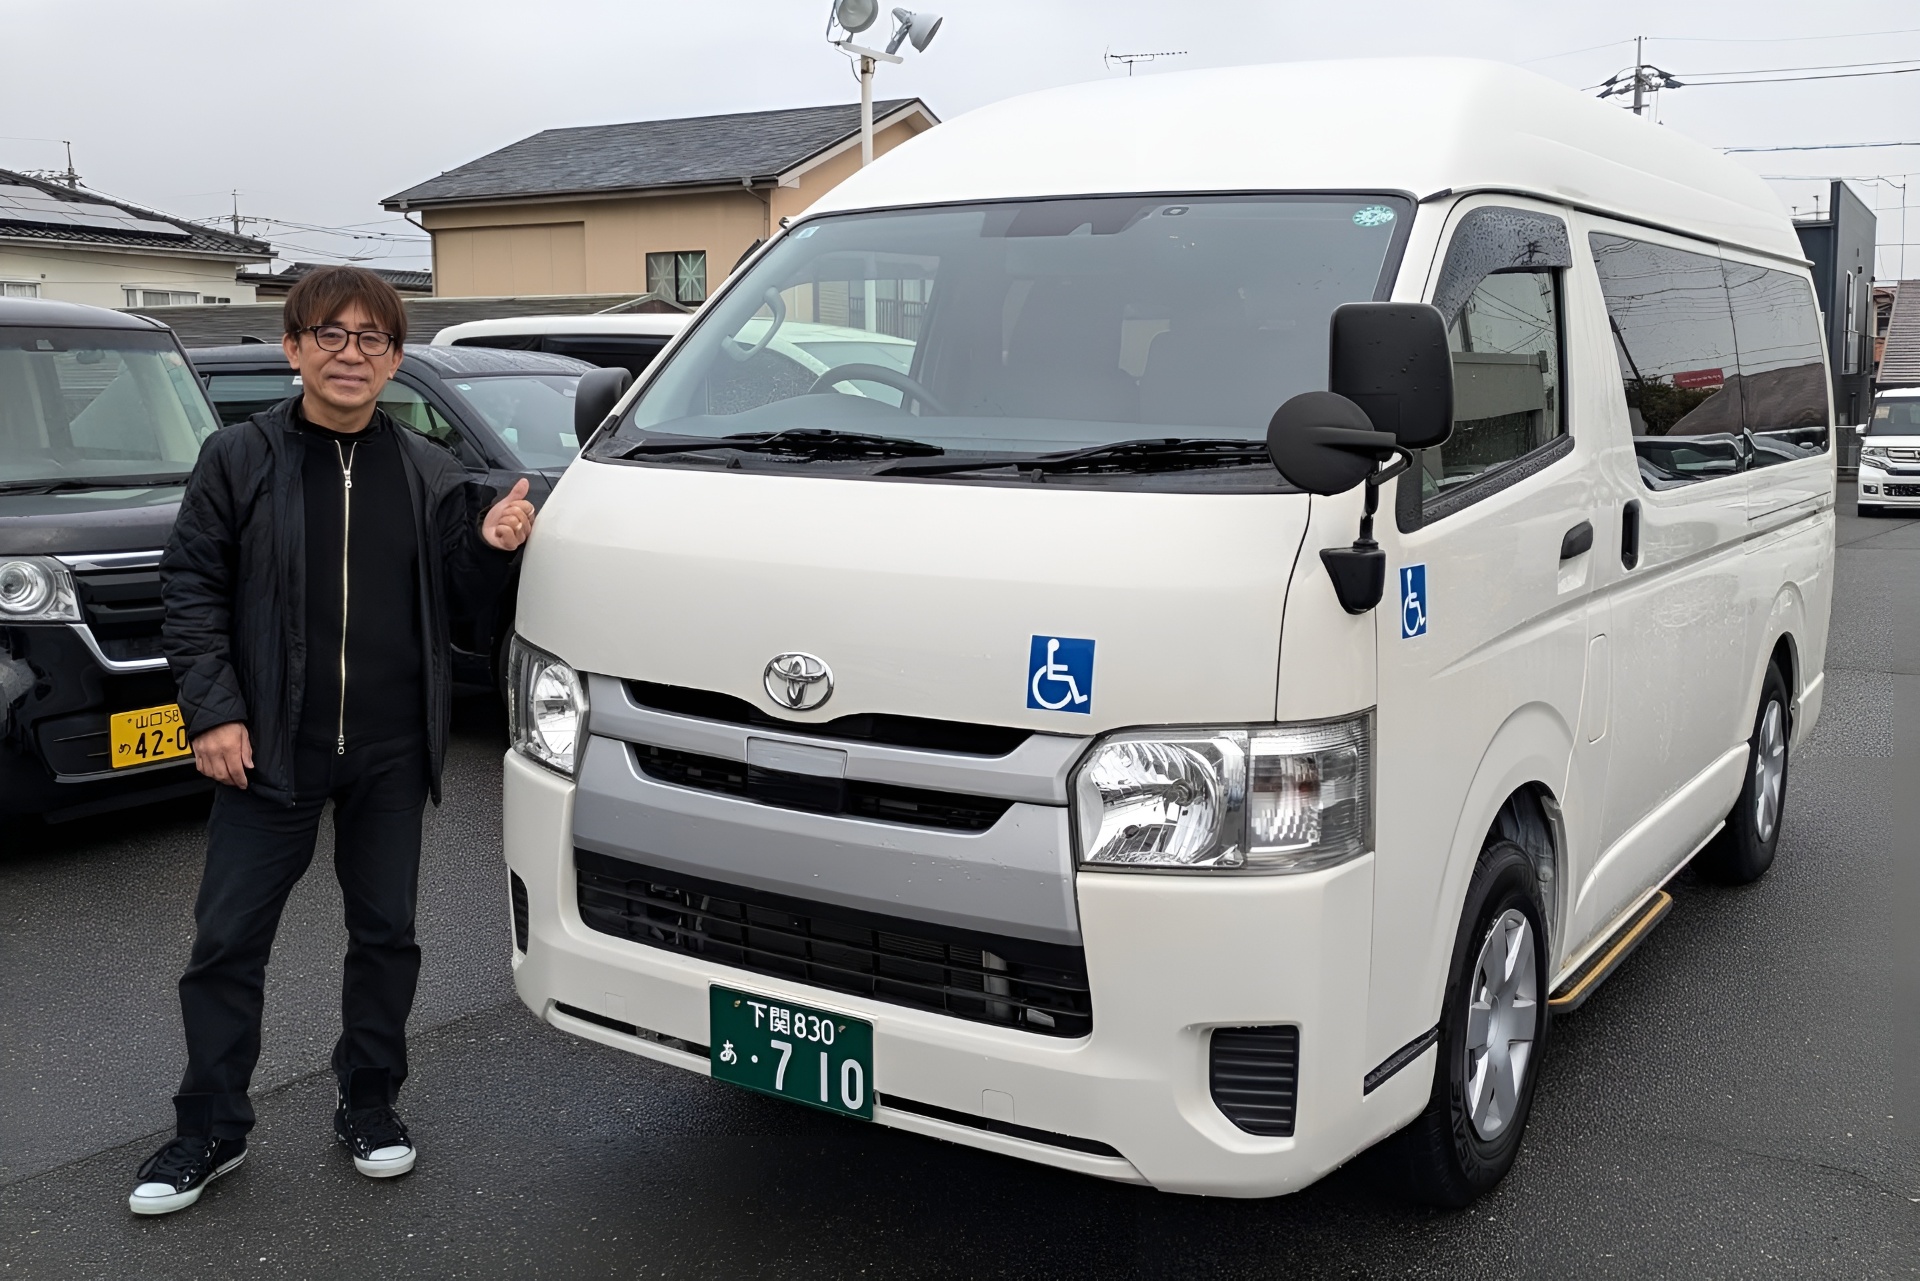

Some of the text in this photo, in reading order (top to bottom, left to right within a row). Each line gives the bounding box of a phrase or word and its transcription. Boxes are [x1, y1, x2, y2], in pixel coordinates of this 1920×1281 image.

[136, 709, 180, 729] 山口58
[135, 725, 188, 759] 42-0
[719, 1039, 738, 1065] あ
